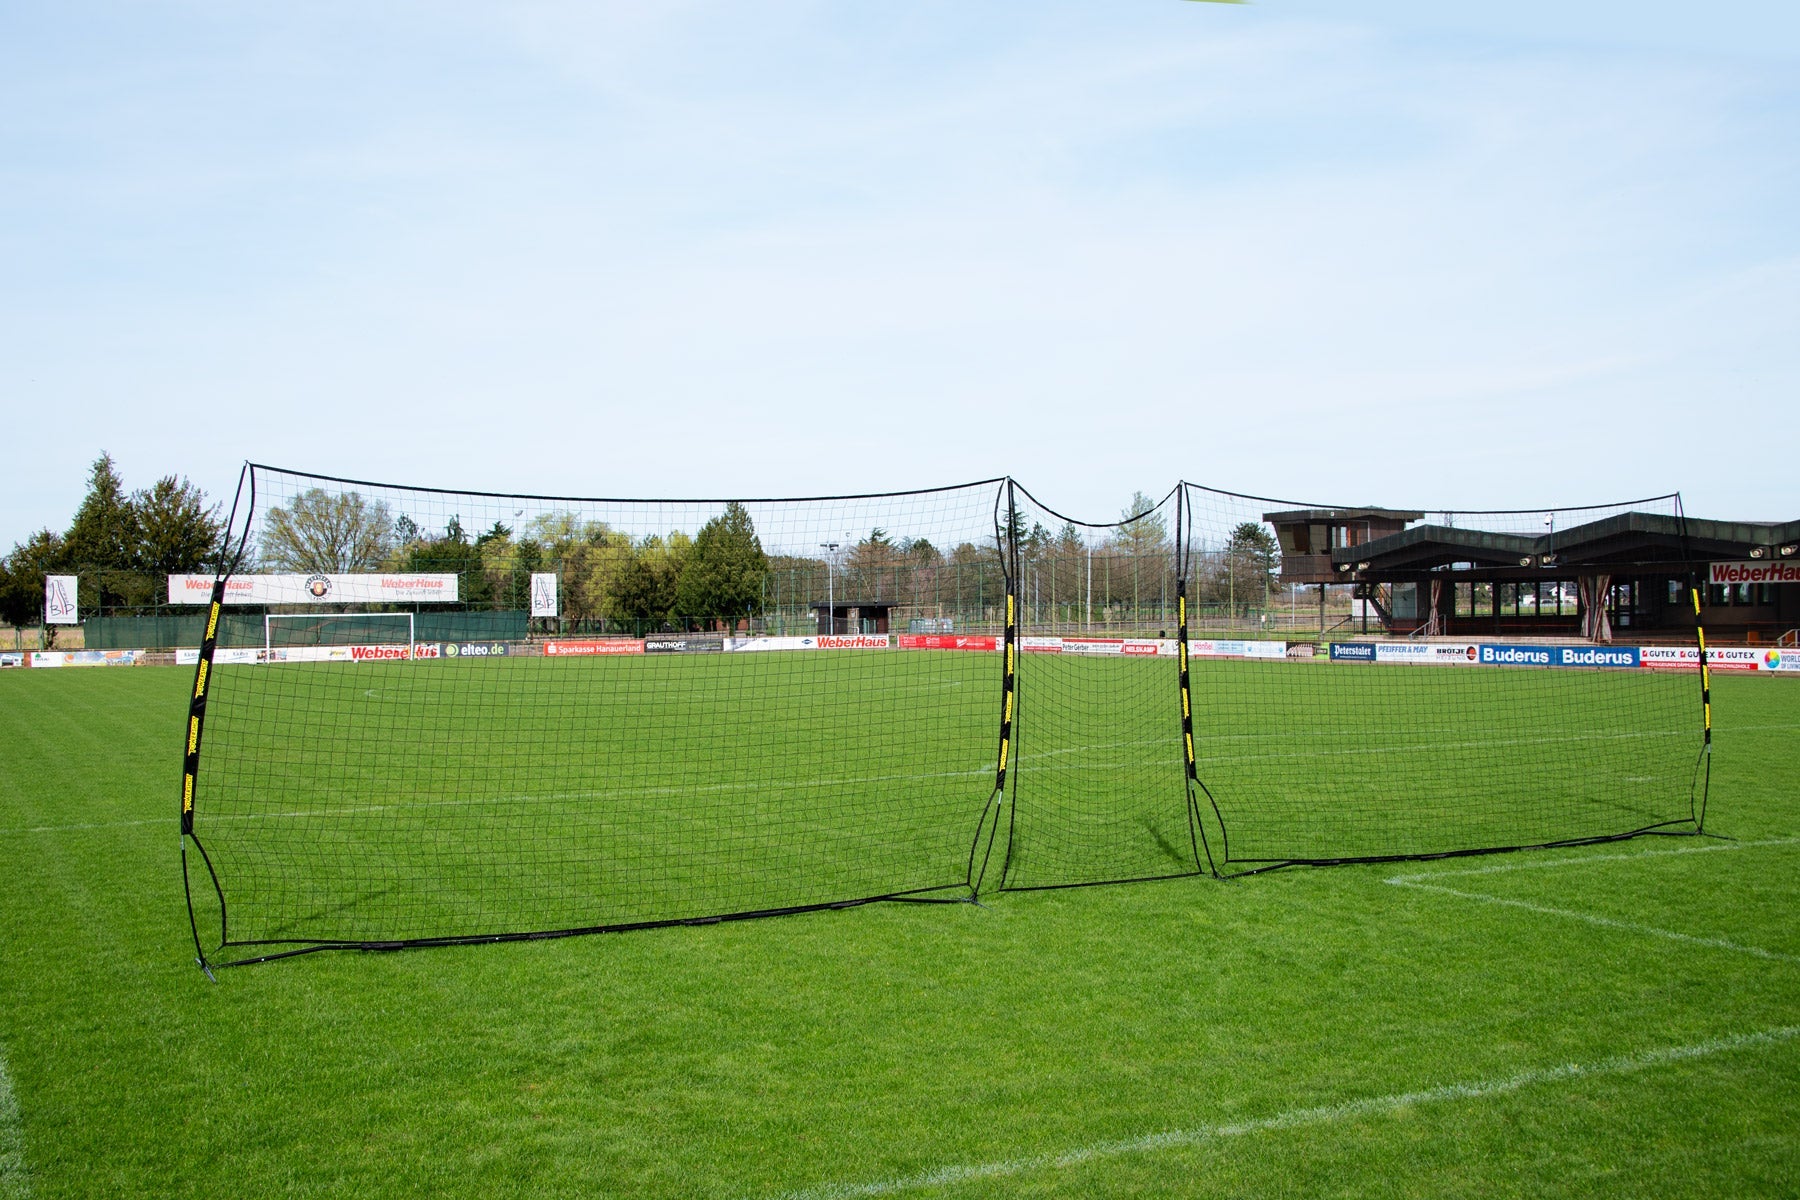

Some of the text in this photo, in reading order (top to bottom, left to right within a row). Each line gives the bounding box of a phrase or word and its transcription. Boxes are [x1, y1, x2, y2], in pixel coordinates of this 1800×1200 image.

[1712, 563, 1800, 582] WeberHa
[185, 580, 253, 590] WebHaus
[381, 579, 443, 588] WeberHaus
[205, 601, 220, 641] POWERSHOT
[646, 641, 686, 649] GRAUTHOFF
[817, 636, 887, 648] WeberHaus
[461, 644, 504, 655] elteo.de
[558, 644, 641, 654] Sparkasse Hanauerland
[1334, 645, 1371, 656] Peterstaler
[1483, 647, 1549, 663] Buderus
[1725, 651, 1755, 659] GUTEX
[1562, 649, 1633, 664] Buderus
[195, 658, 208, 699] POWERSHOT
[188, 716, 199, 756] POWERSHOT
[184, 773, 193, 813] POWERSHOT
